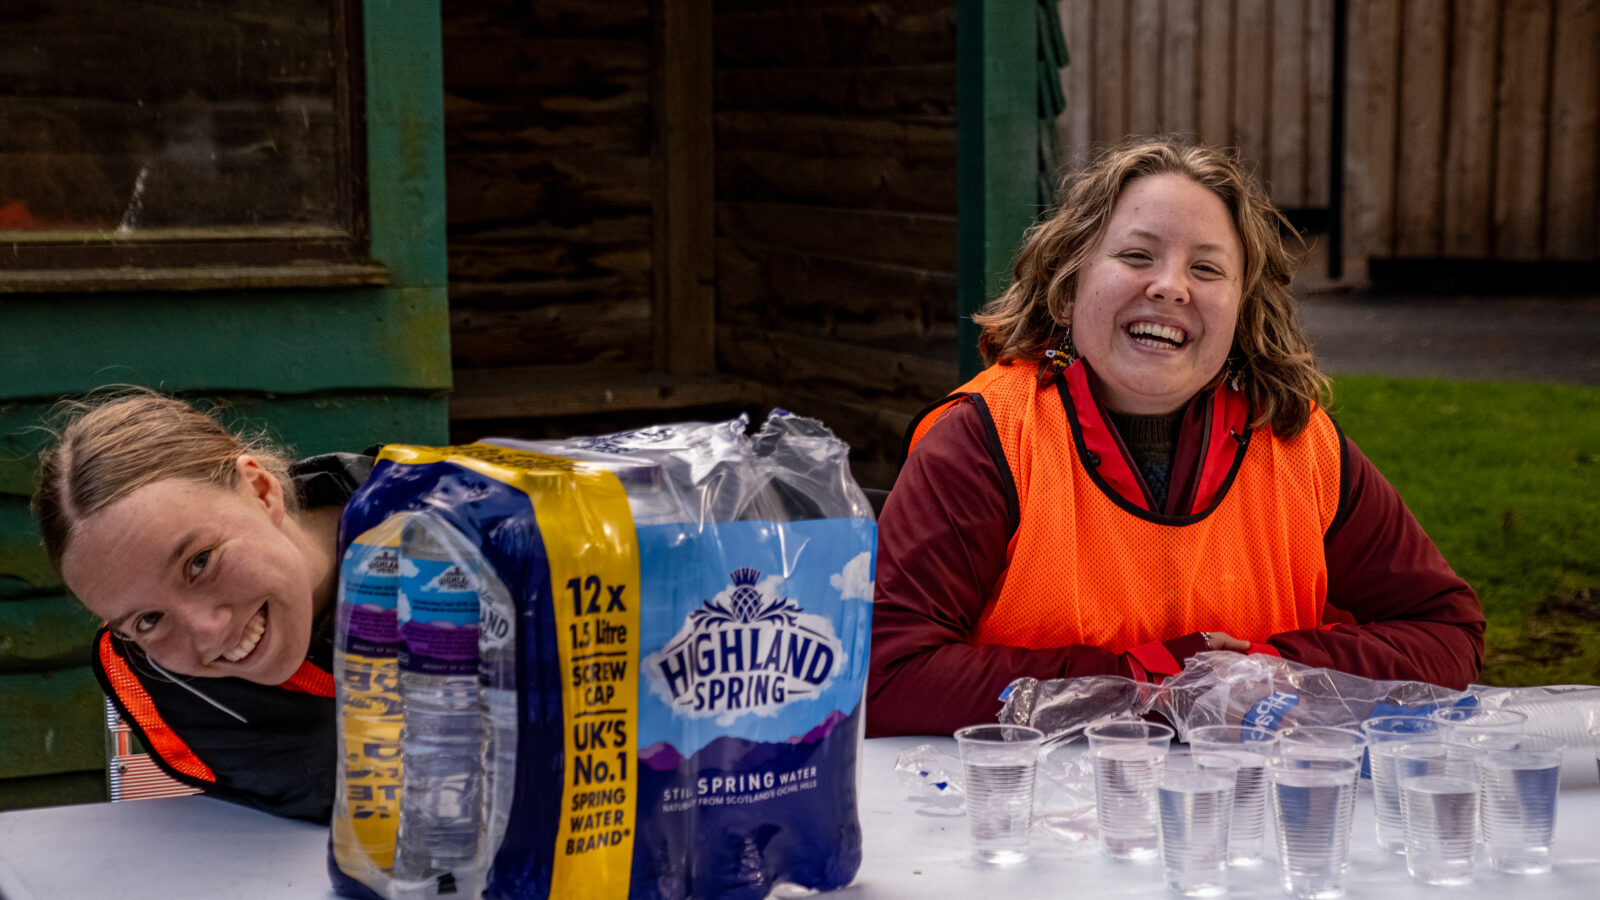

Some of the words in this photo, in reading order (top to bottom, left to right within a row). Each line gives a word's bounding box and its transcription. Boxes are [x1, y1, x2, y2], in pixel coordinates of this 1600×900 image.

[566, 574, 602, 617] 12
[606, 585, 627, 613] x
[569, 621, 591, 650] 1.5
[572, 661, 627, 687] SCREW
[659, 628, 834, 700] HIGHLAND
[585, 685, 615, 707] CAP
[694, 675, 785, 711] SPRING
[574, 720, 627, 751] UK'S
[573, 752, 627, 787] No.1
[663, 787, 694, 802] STIL
[697, 771, 775, 795] SPRING
[779, 766, 817, 785] WATER
[571, 788, 627, 812] SPRING
[698, 796, 725, 807] FROM
[800, 779, 817, 791] HILLS
[570, 810, 624, 834] WATER
